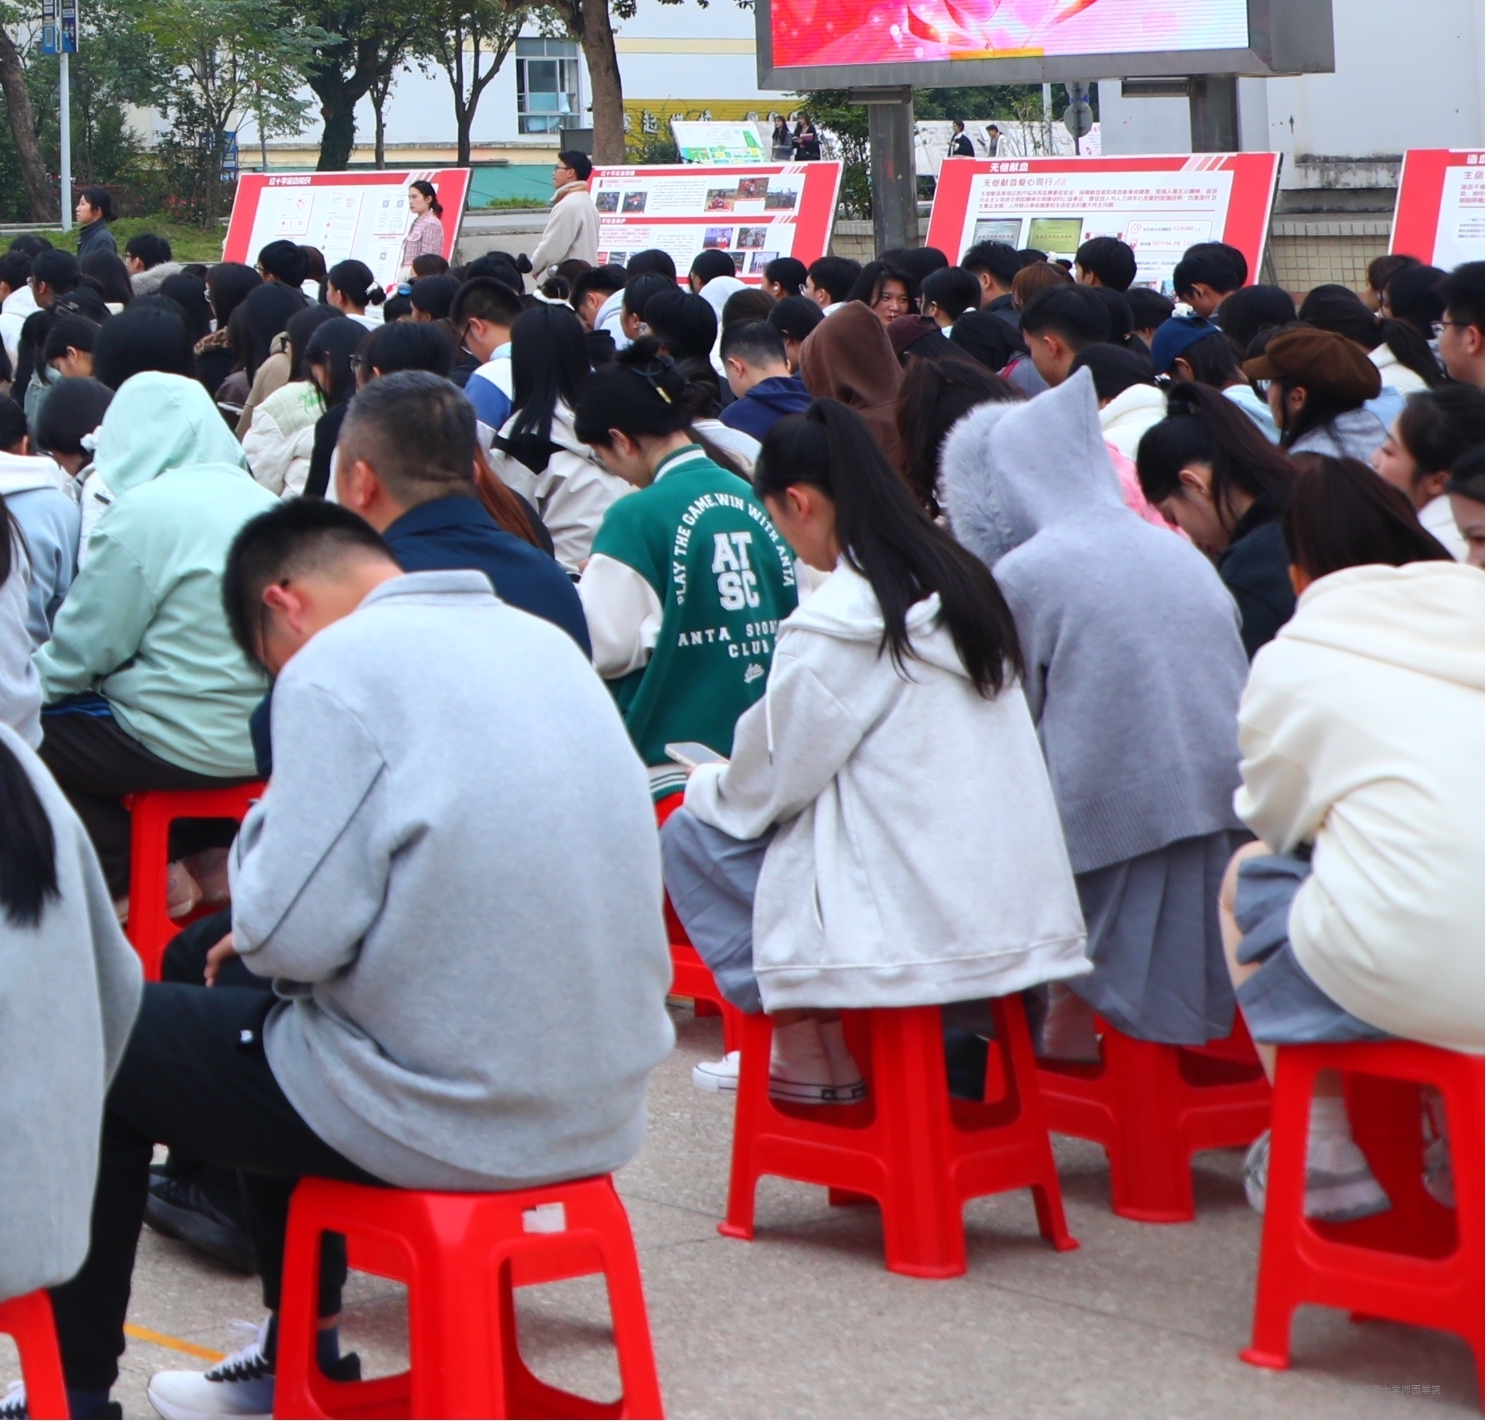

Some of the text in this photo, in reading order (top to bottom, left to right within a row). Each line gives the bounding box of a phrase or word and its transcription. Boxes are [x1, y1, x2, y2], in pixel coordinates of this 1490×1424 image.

[674, 525, 692, 557] THE
[747, 503, 780, 543] WITH
[775, 545, 795, 587] ANTA
[711, 531, 753, 574] AT
[717, 570, 760, 611] SC
[677, 626, 731, 647] ANTA
[728, 639, 769, 659] CLUB
